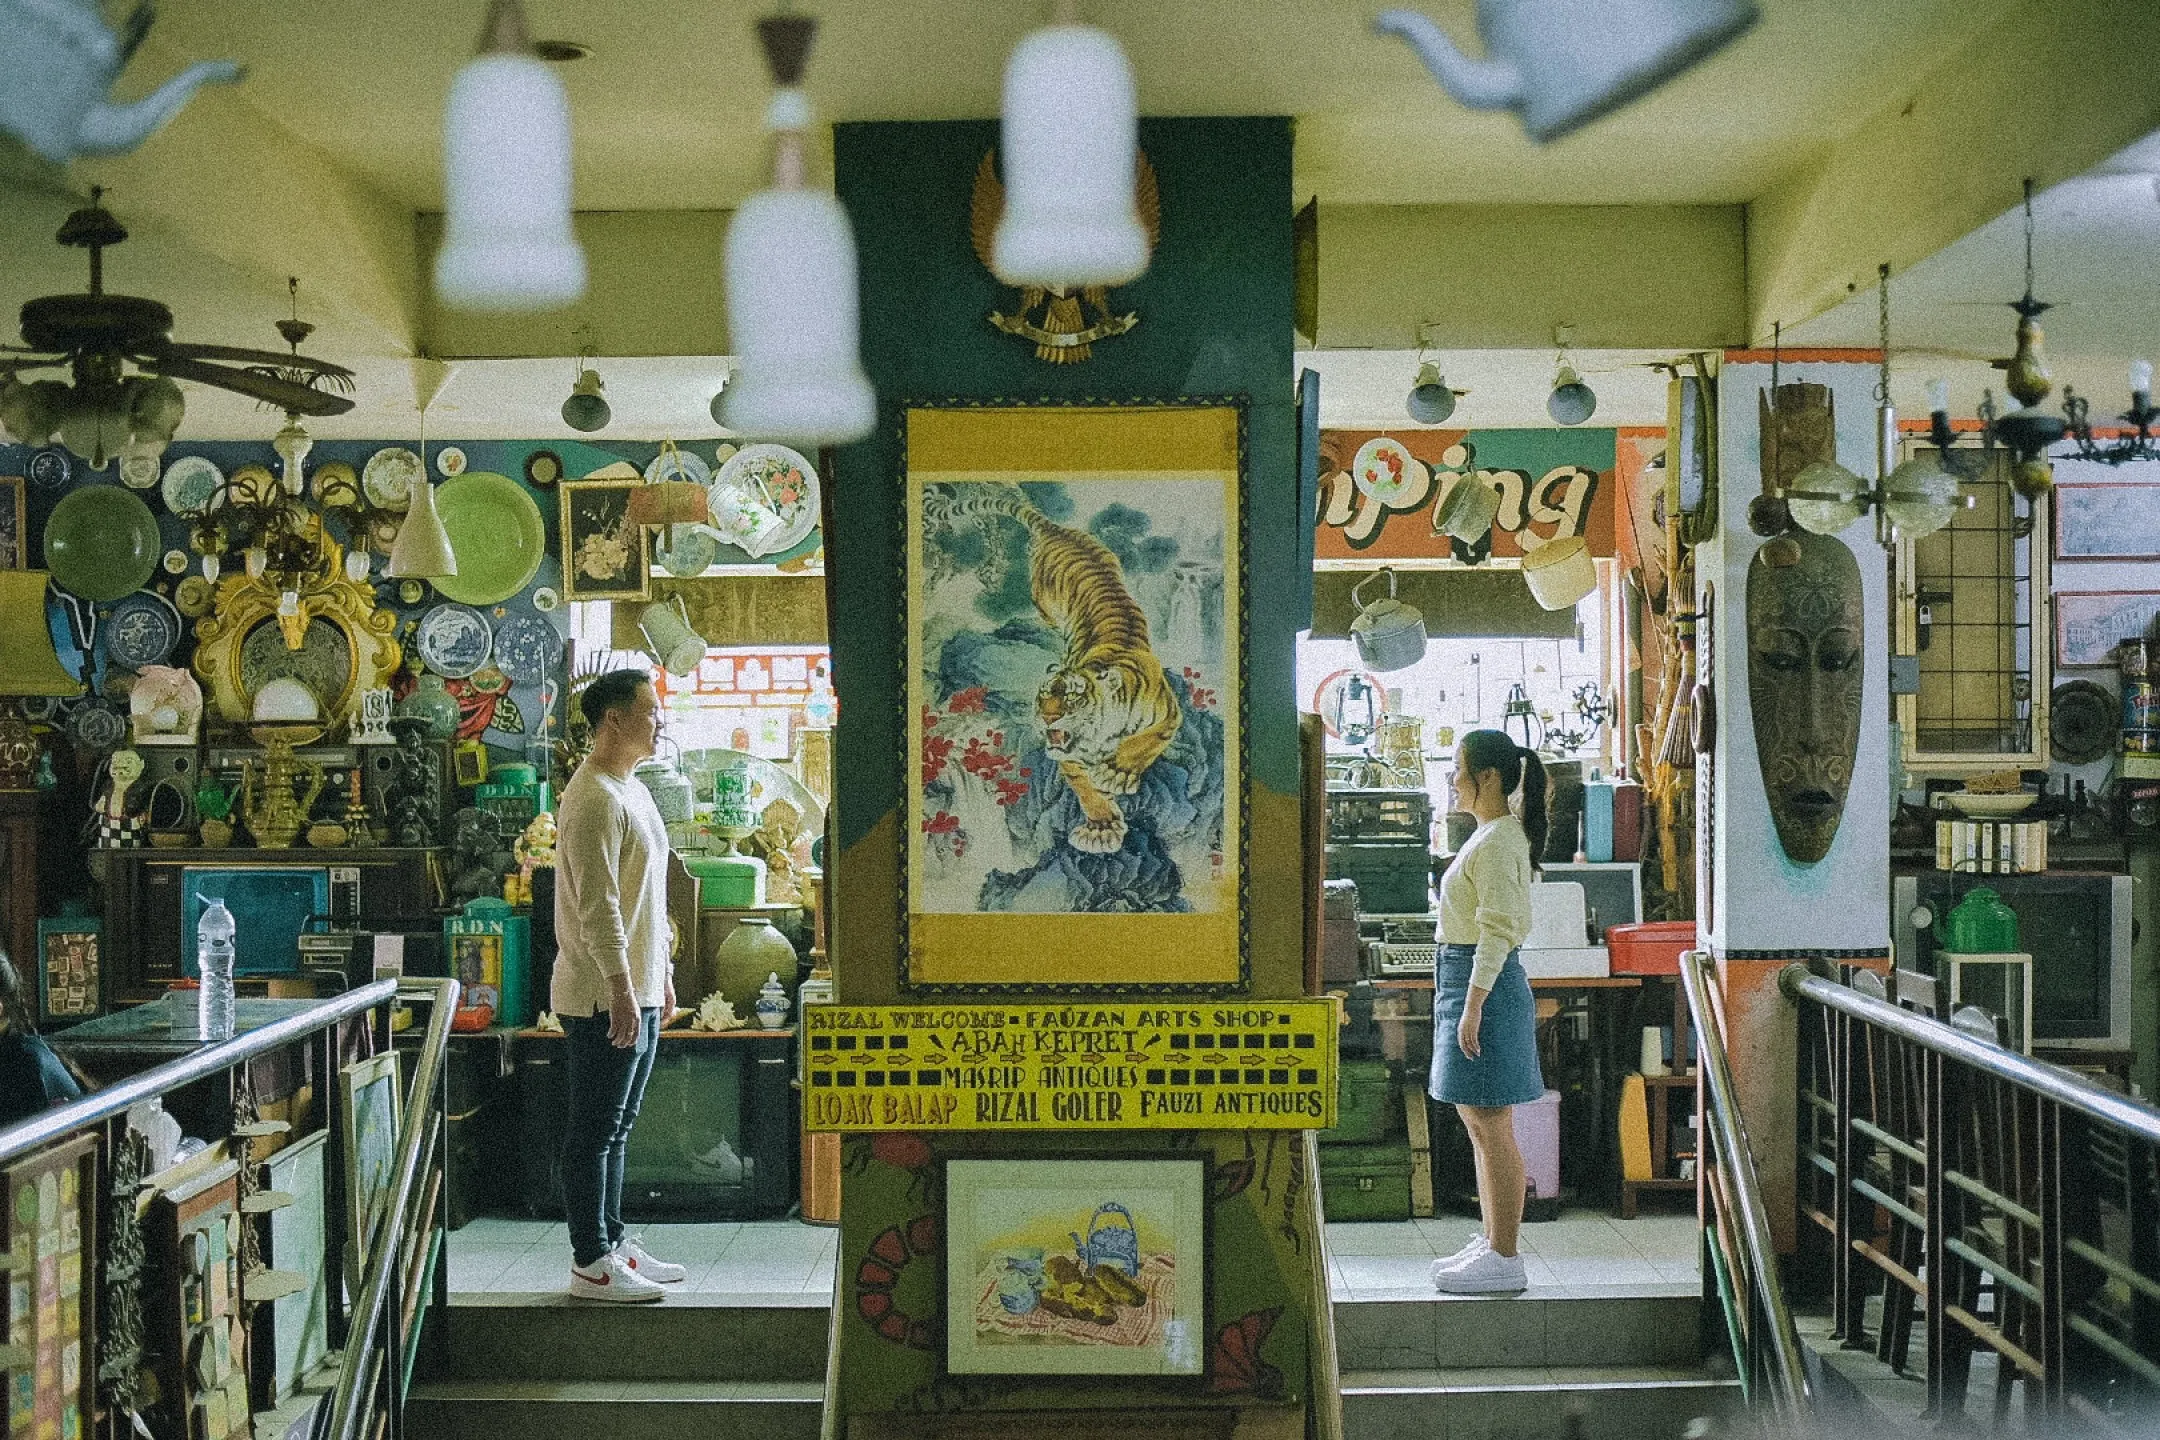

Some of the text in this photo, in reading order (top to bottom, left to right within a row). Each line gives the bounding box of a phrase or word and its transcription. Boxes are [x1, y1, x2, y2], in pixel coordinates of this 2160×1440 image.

[809, 1011, 883, 1030] RIZAL
[889, 1011, 1005, 1029] WELCOME
[1136, 1010, 1201, 1027] ARTS
[1213, 1010, 1275, 1027] SHOP
[951, 1029, 1138, 1053] ABAH KEPRET
[944, 1066, 1138, 1090] MASRIP ANTIQUES
[812, 1090, 1323, 1125] LOAK BALAP RIZAL GOLER FAUZI ANTIQUES
